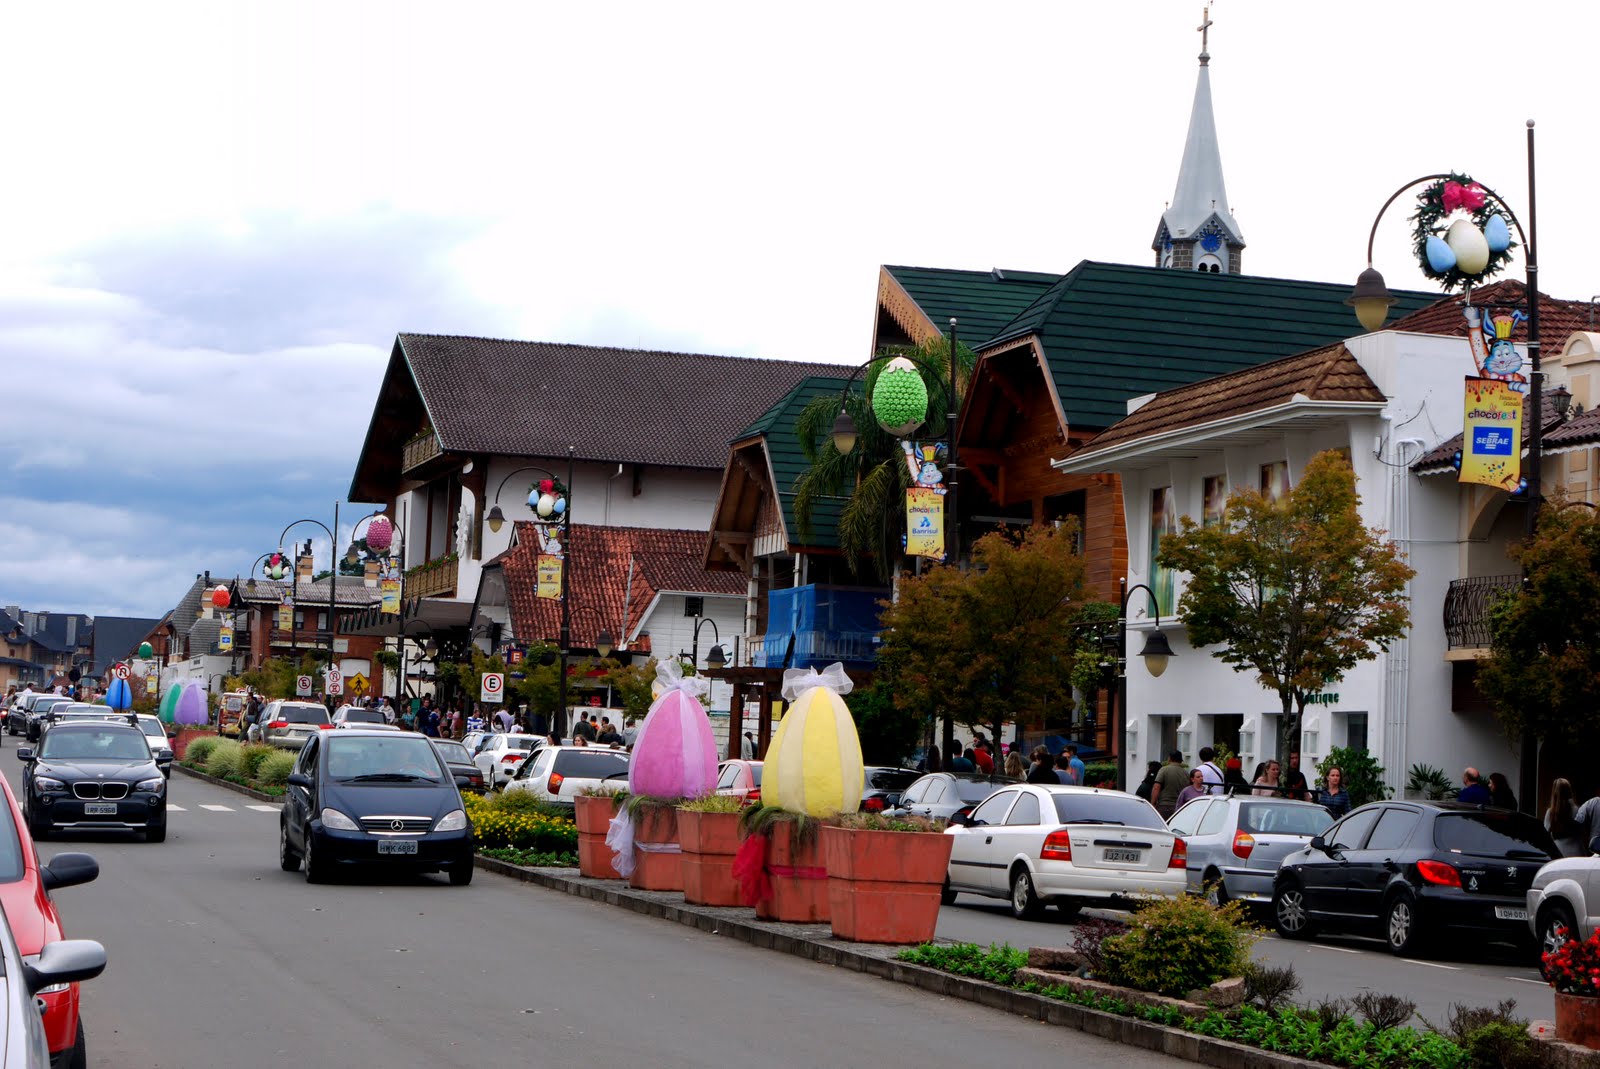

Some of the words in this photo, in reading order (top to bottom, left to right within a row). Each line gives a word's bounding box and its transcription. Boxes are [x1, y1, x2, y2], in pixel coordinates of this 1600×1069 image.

[1468, 408, 1517, 421] chocofest
[1476, 437, 1509, 445] SEBRAE
[489, 678, 496, 688] E
[1301, 691, 1340, 708] outique
[1121, 853, 1139, 862] 1431
